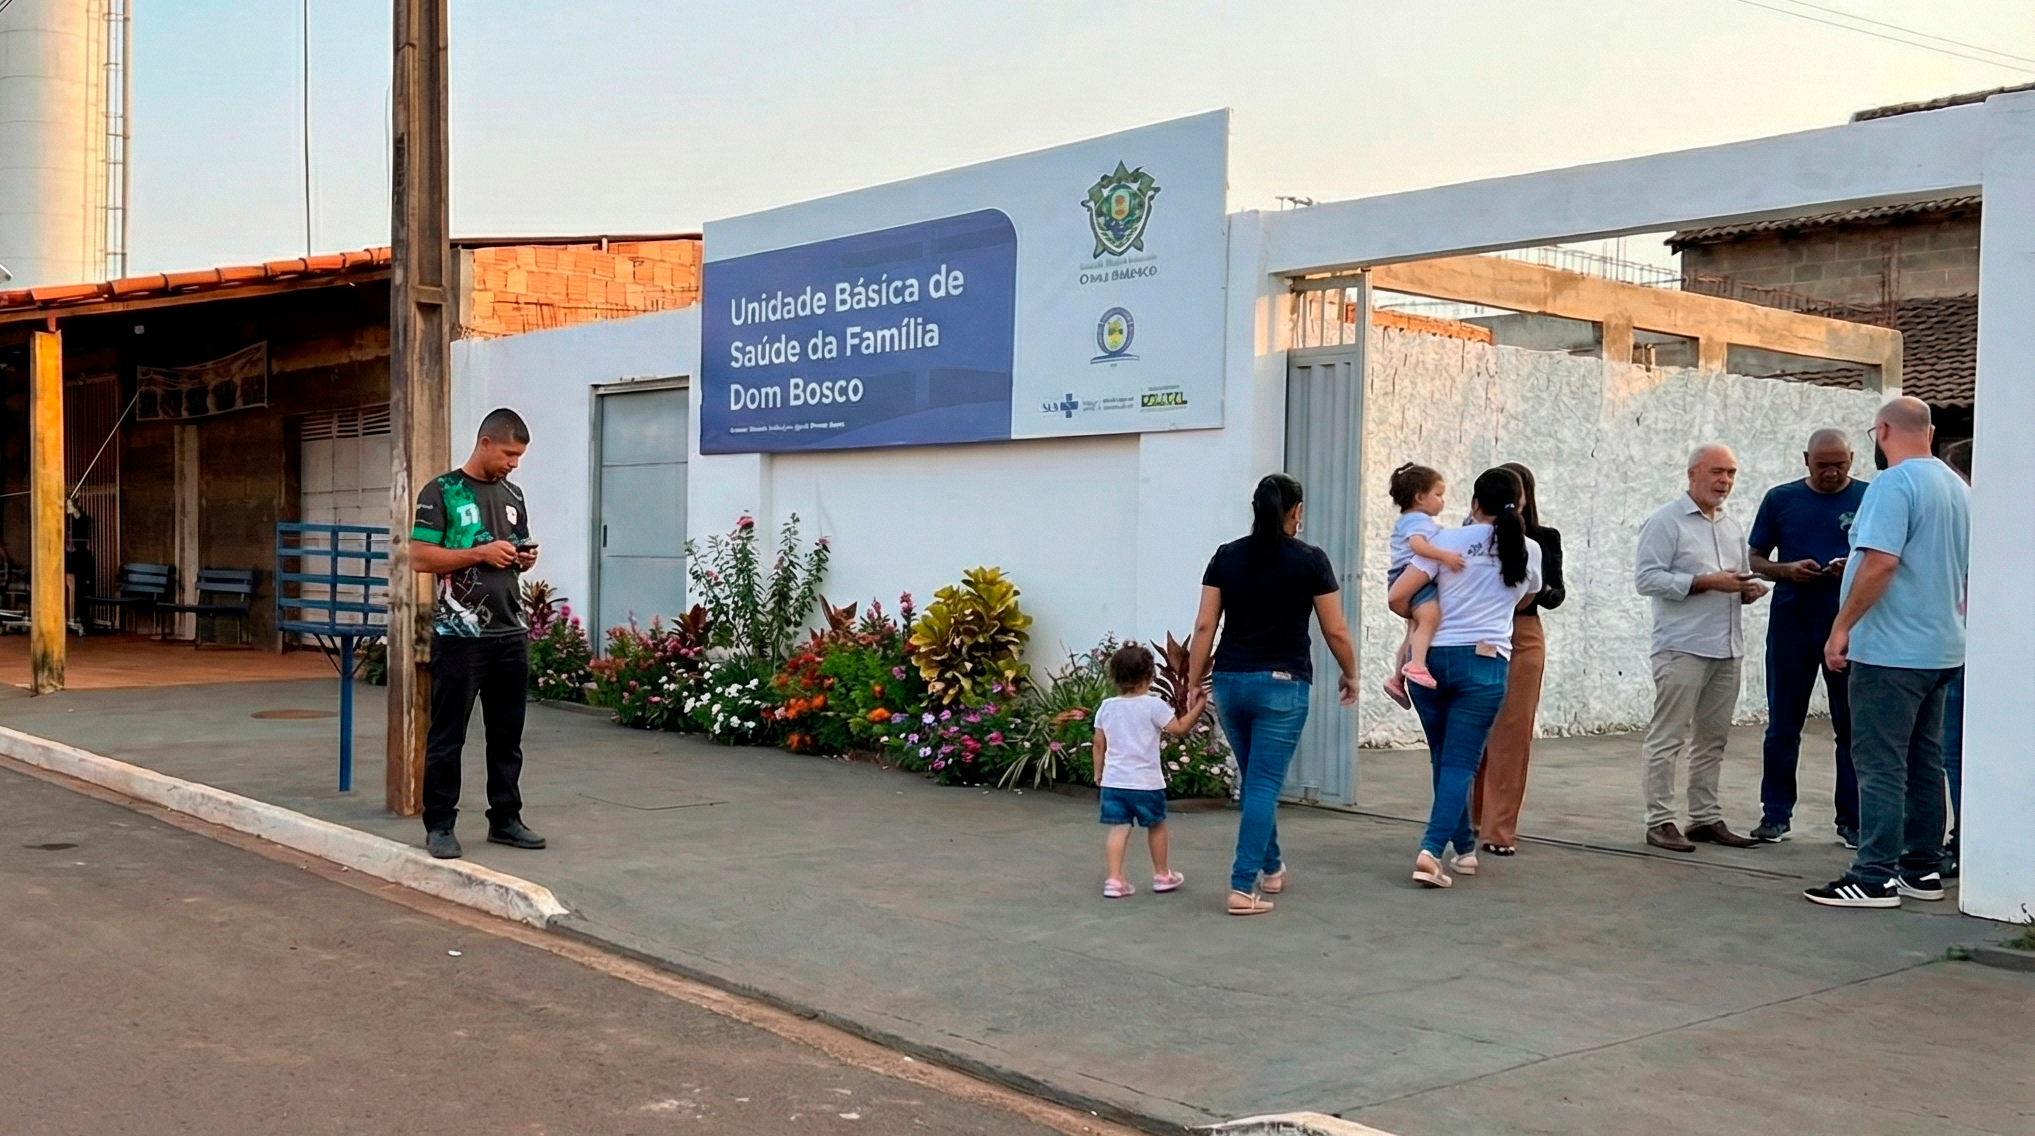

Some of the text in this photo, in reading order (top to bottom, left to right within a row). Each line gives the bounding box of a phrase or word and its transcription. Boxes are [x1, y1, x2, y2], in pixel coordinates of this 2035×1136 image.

[731, 285, 827, 326] Unidade
[928, 263, 964, 299] de
[730, 317, 939, 368] Saúde da Família
[730, 377, 864, 411] Dom Bosco
